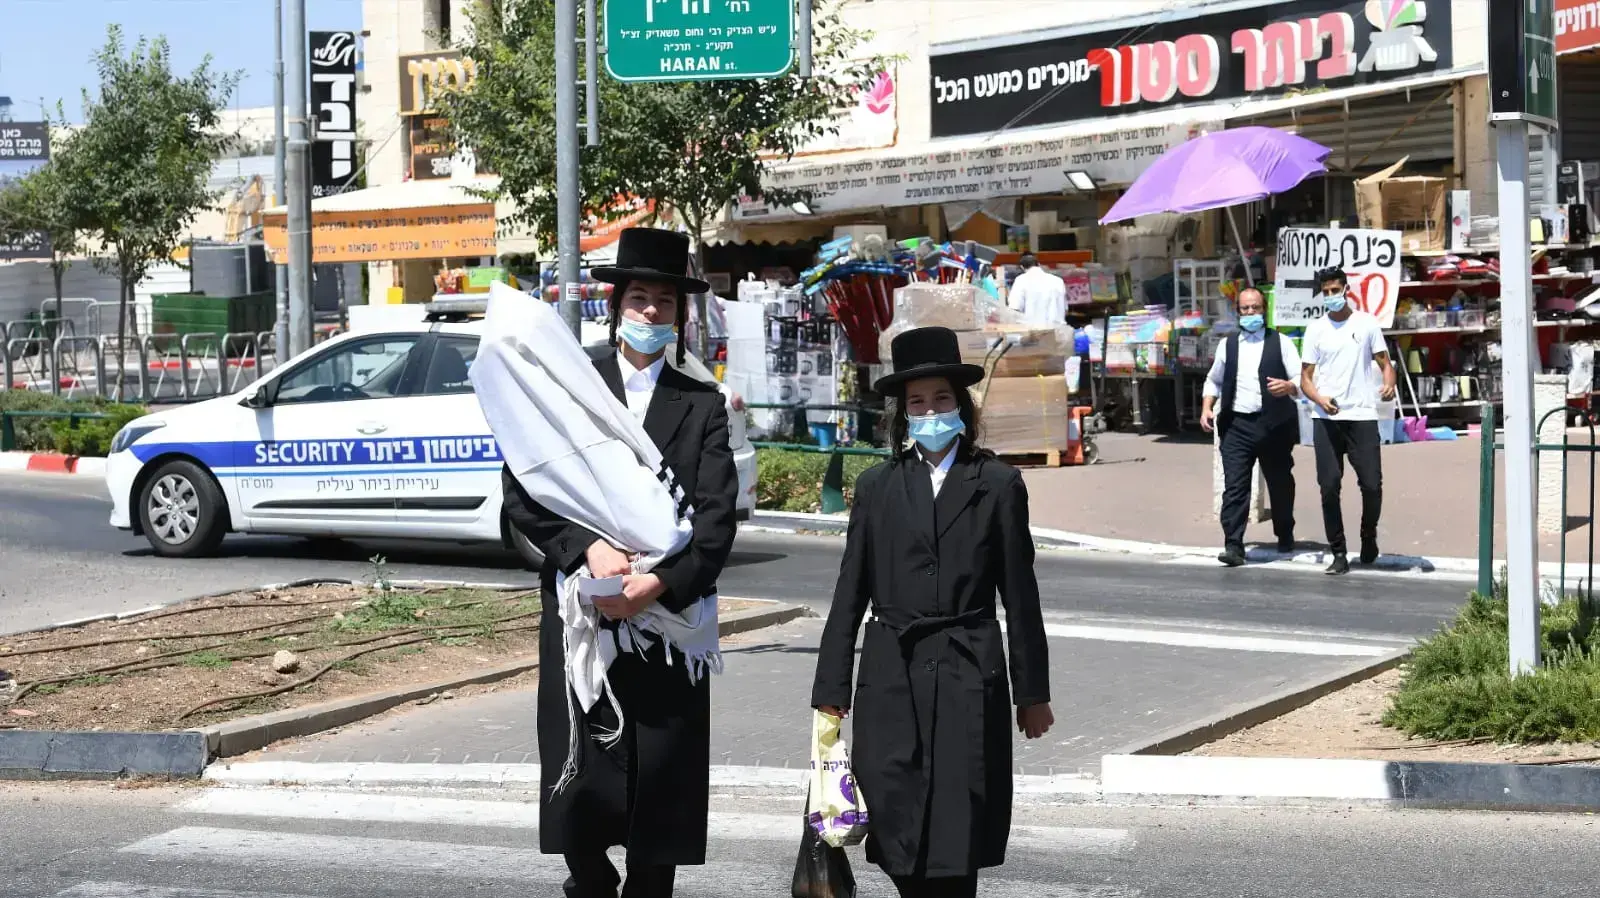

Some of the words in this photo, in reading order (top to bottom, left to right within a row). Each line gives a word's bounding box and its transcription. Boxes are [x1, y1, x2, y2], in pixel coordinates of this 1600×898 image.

[1556, 2, 1600, 35] רונים
[620, 28, 641, 39] זצ"ל
[646, 29, 680, 40] משאדיק
[685, 28, 704, 37] נחום
[708, 27, 722, 36] רבי
[726, 26, 752, 36] הצדיק
[758, 25, 777, 34] ע"ש
[664, 42, 692, 52] תרכ"ה
[706, 41, 734, 52] תקע"ג
[1231, 12, 1357, 92] ביתר
[660, 56, 720, 72] HARAN
[724, 61, 738, 70] st.
[1087, 34, 1220, 107] סטור
[1027, 58, 1091, 91] מוכרים
[934, 76, 970, 104] הכל
[974, 69, 1024, 98] כמעט
[254, 441, 354, 464] SECURITY
[362, 441, 417, 462] ביתר
[422, 438, 498, 464] ביטחון
[240, 476, 274, 490] מוס"ח
[316, 478, 355, 492] עילית
[358, 478, 392, 491] ביתר
[395, 476, 440, 490] עיריית
